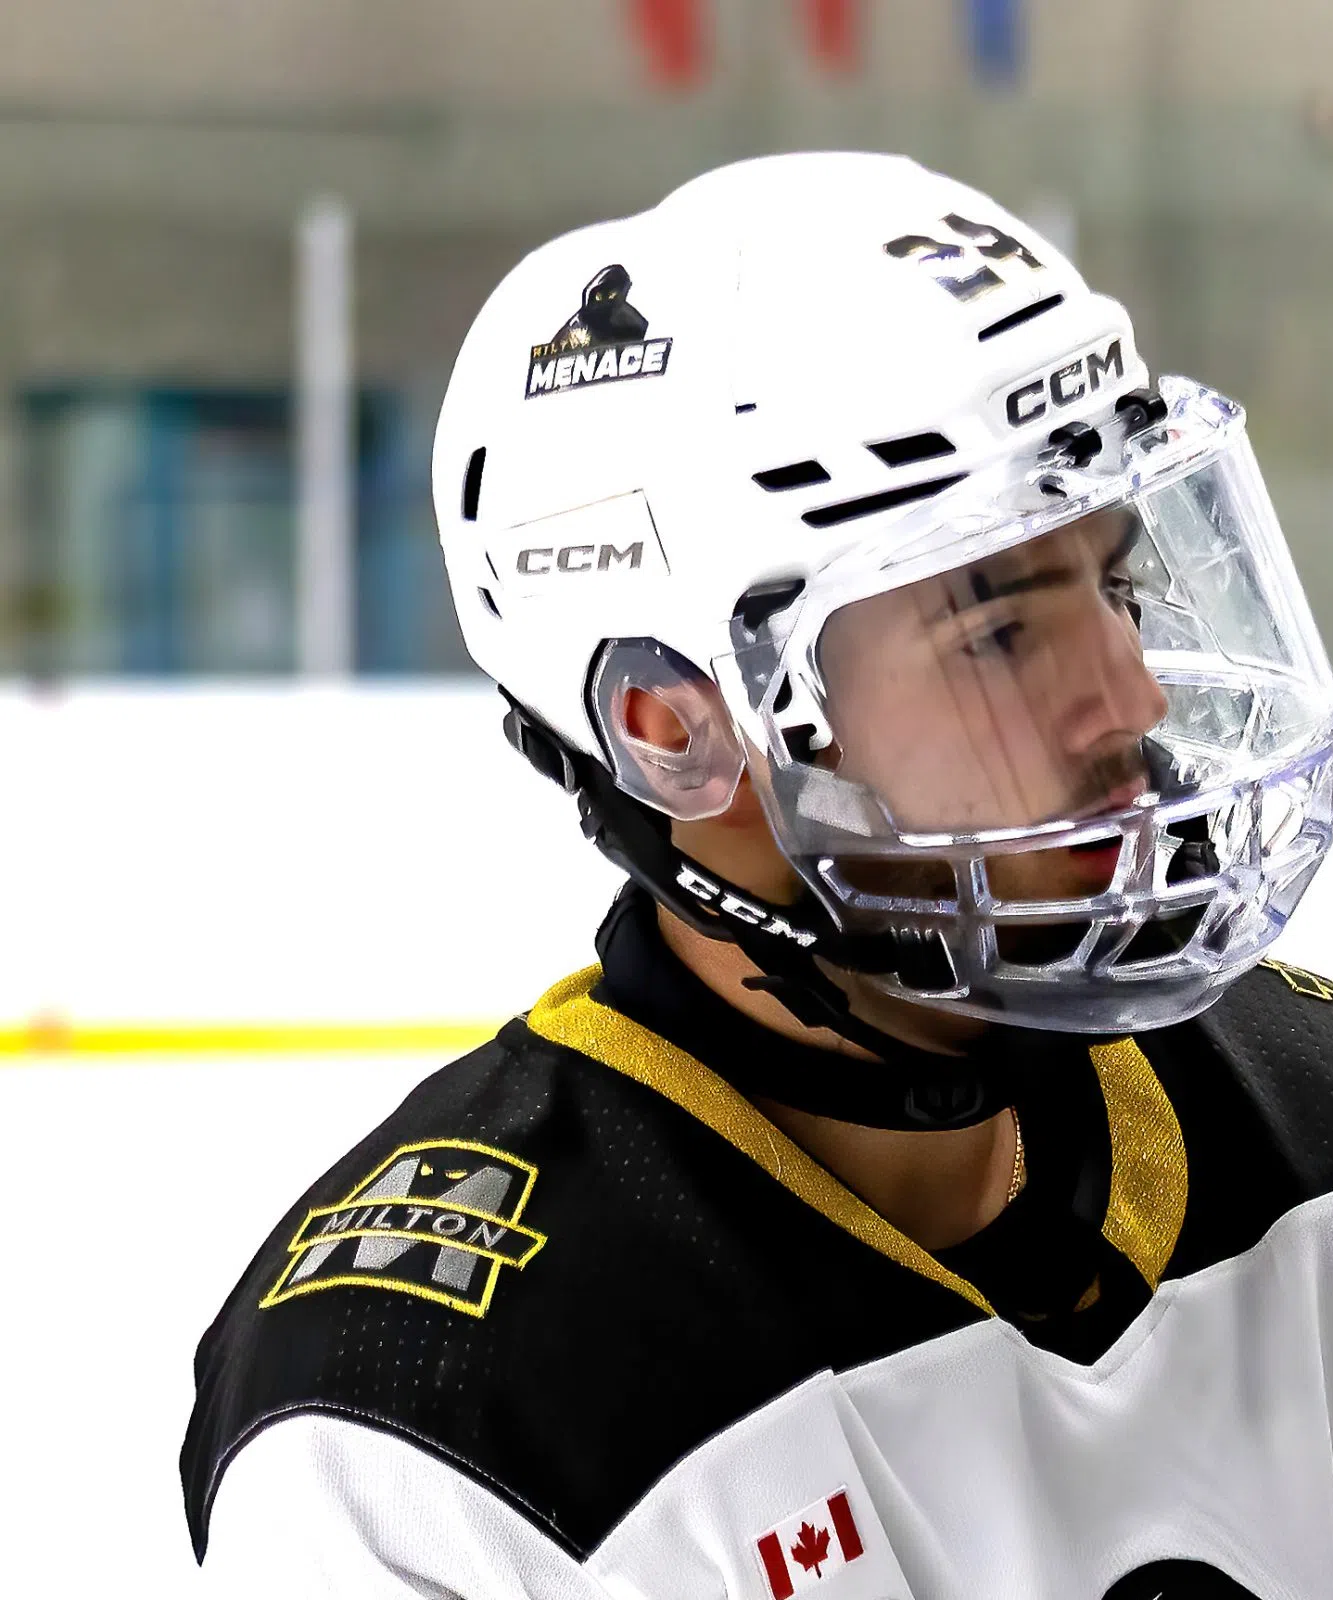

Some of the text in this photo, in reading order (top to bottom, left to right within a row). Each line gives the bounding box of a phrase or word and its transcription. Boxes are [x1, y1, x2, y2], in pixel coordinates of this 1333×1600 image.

[528, 341, 667, 394] MENACE
[1006, 338, 1124, 428] CCM
[516, 541, 644, 577] CCM
[319, 1206, 508, 1249] MILTON
